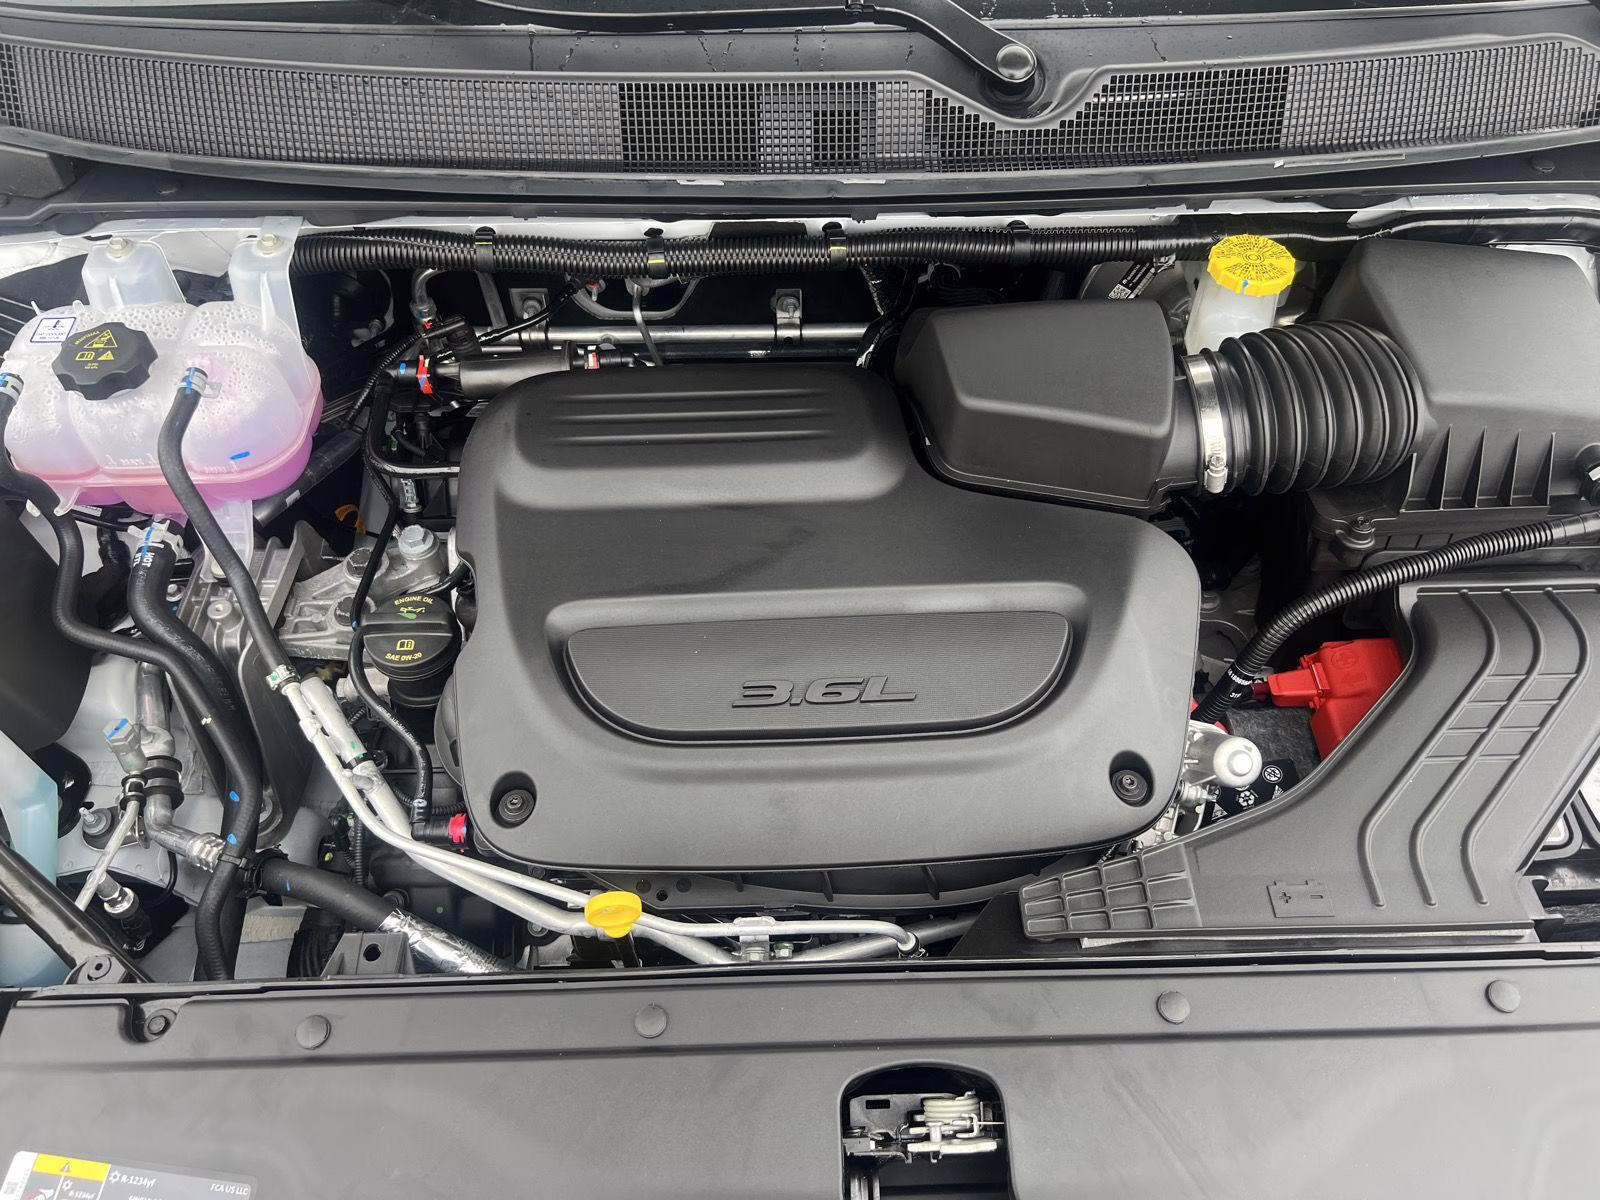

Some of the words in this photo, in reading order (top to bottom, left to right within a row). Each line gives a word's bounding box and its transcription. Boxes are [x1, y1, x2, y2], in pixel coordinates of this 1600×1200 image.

[141, 551, 155, 568] HOT
[394, 595, 421, 606] ENGINE
[422, 596, 434, 605] OIL
[385, 652, 400, 661] SAE
[731, 675, 918, 708] 3.6L
[120, 1174, 156, 1189] R-1234yf
[210, 1183, 224, 1194] FCA
[225, 1184, 235, 1194] US
[236, 1186, 249, 1196] LLC
